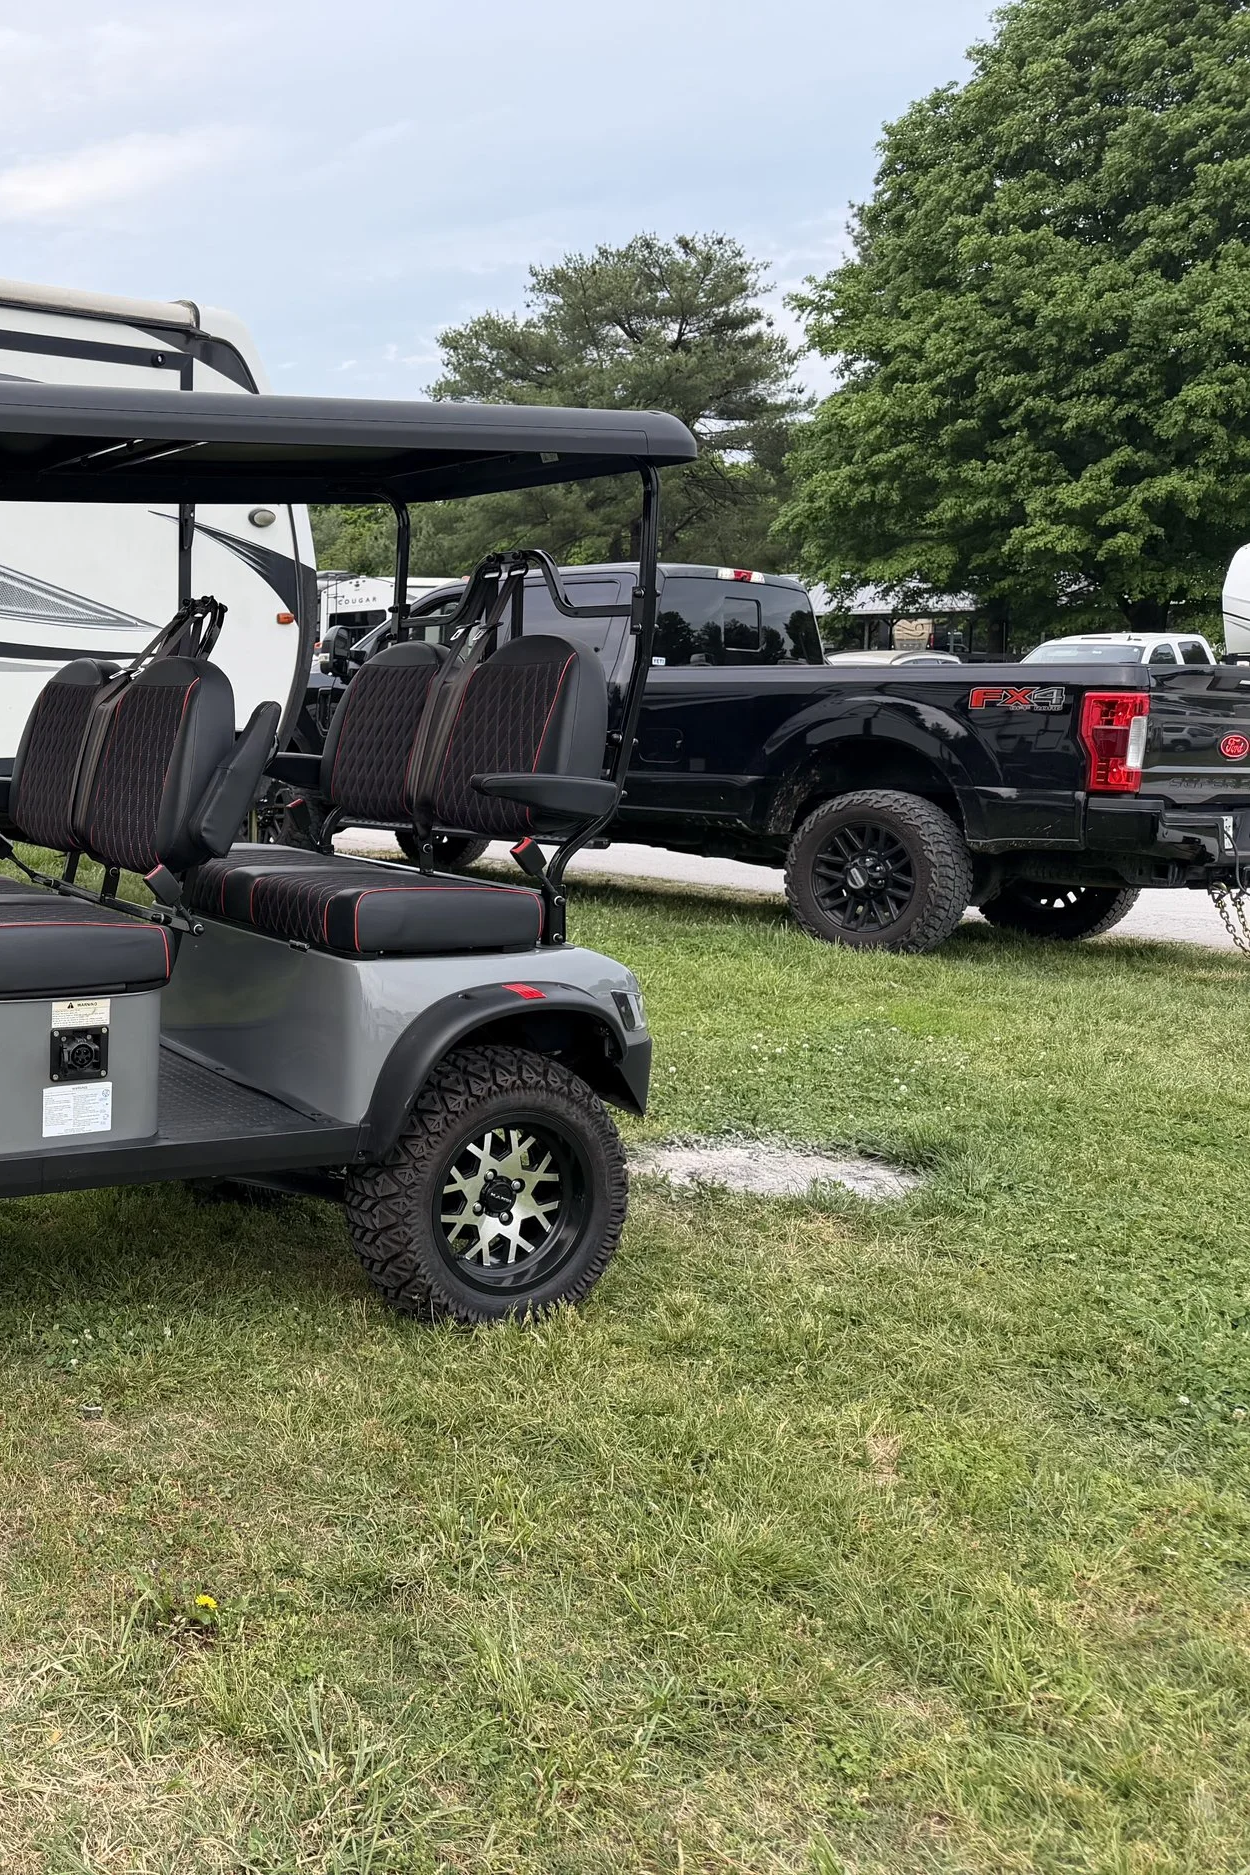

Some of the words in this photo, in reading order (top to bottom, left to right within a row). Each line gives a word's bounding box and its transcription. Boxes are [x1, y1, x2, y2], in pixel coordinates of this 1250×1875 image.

[338, 596, 377, 605] COUGAR
[968, 686, 1065, 709] FX4
[1225, 737, 1245, 754] Ford
